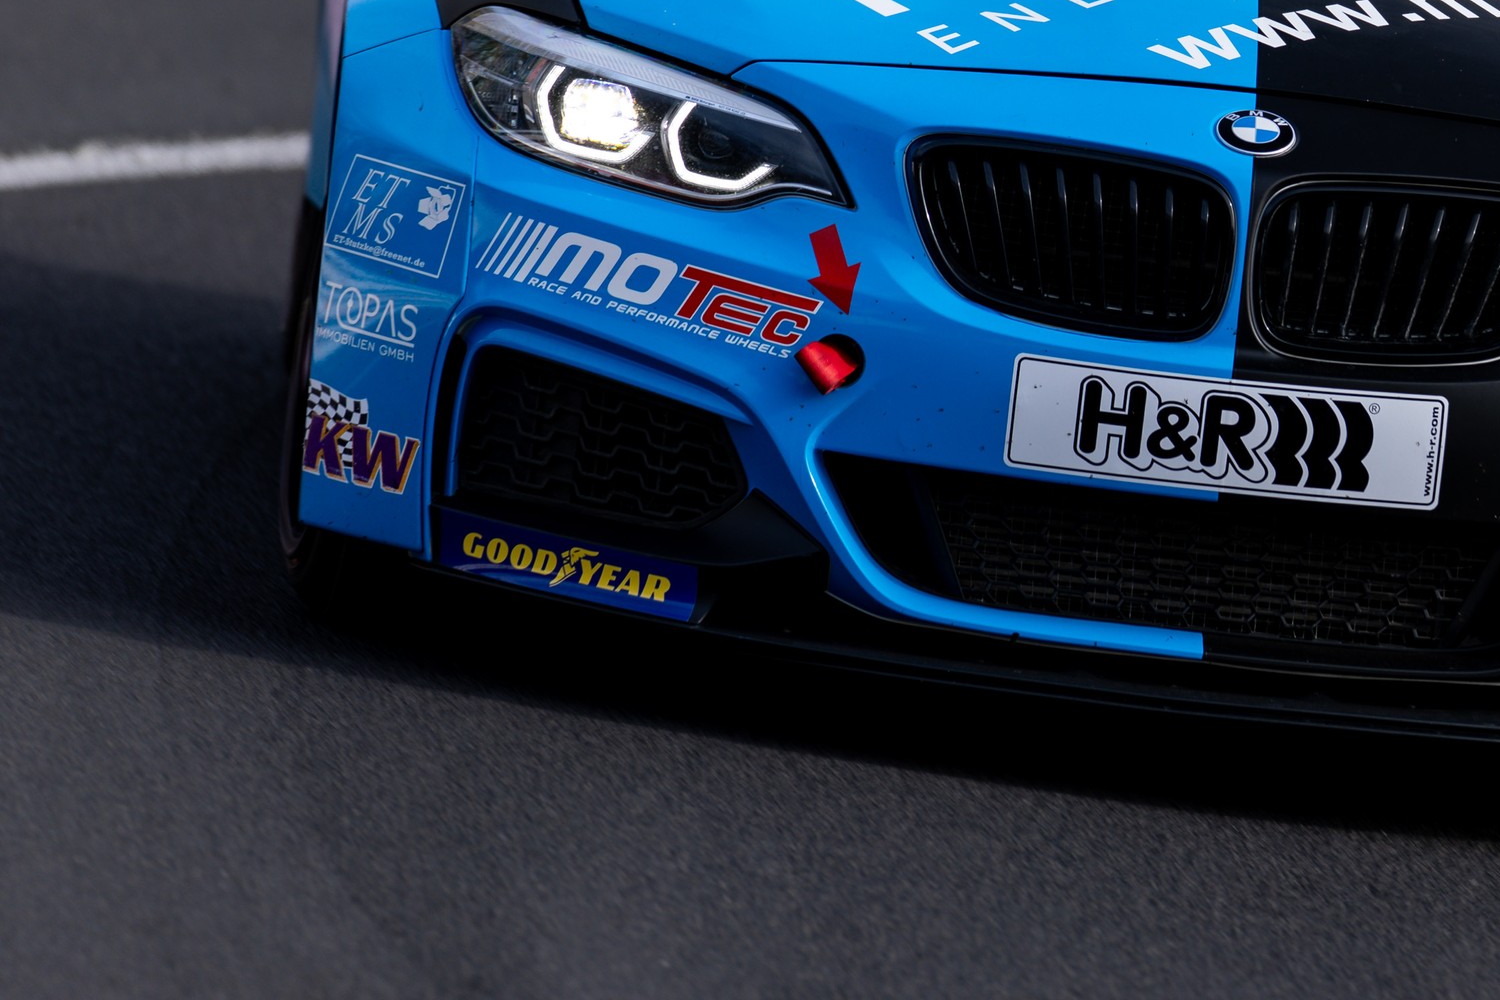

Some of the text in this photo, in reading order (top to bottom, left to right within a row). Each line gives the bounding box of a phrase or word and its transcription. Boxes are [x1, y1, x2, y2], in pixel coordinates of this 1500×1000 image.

[342, 206, 404, 245] MS
[352, 168, 411, 208] ET
[324, 281, 418, 343] TOPAS
[527, 276, 792, 360] RACE AND PERFORMANCE WHEELS
[535, 231, 824, 347] MOTEC
[317, 327, 415, 364] IMMOBILIEN GMBH
[303, 413, 420, 495] KW
[1074, 376, 1272, 483] H&R
[1422, 405, 1441, 498] www.h-r.com
